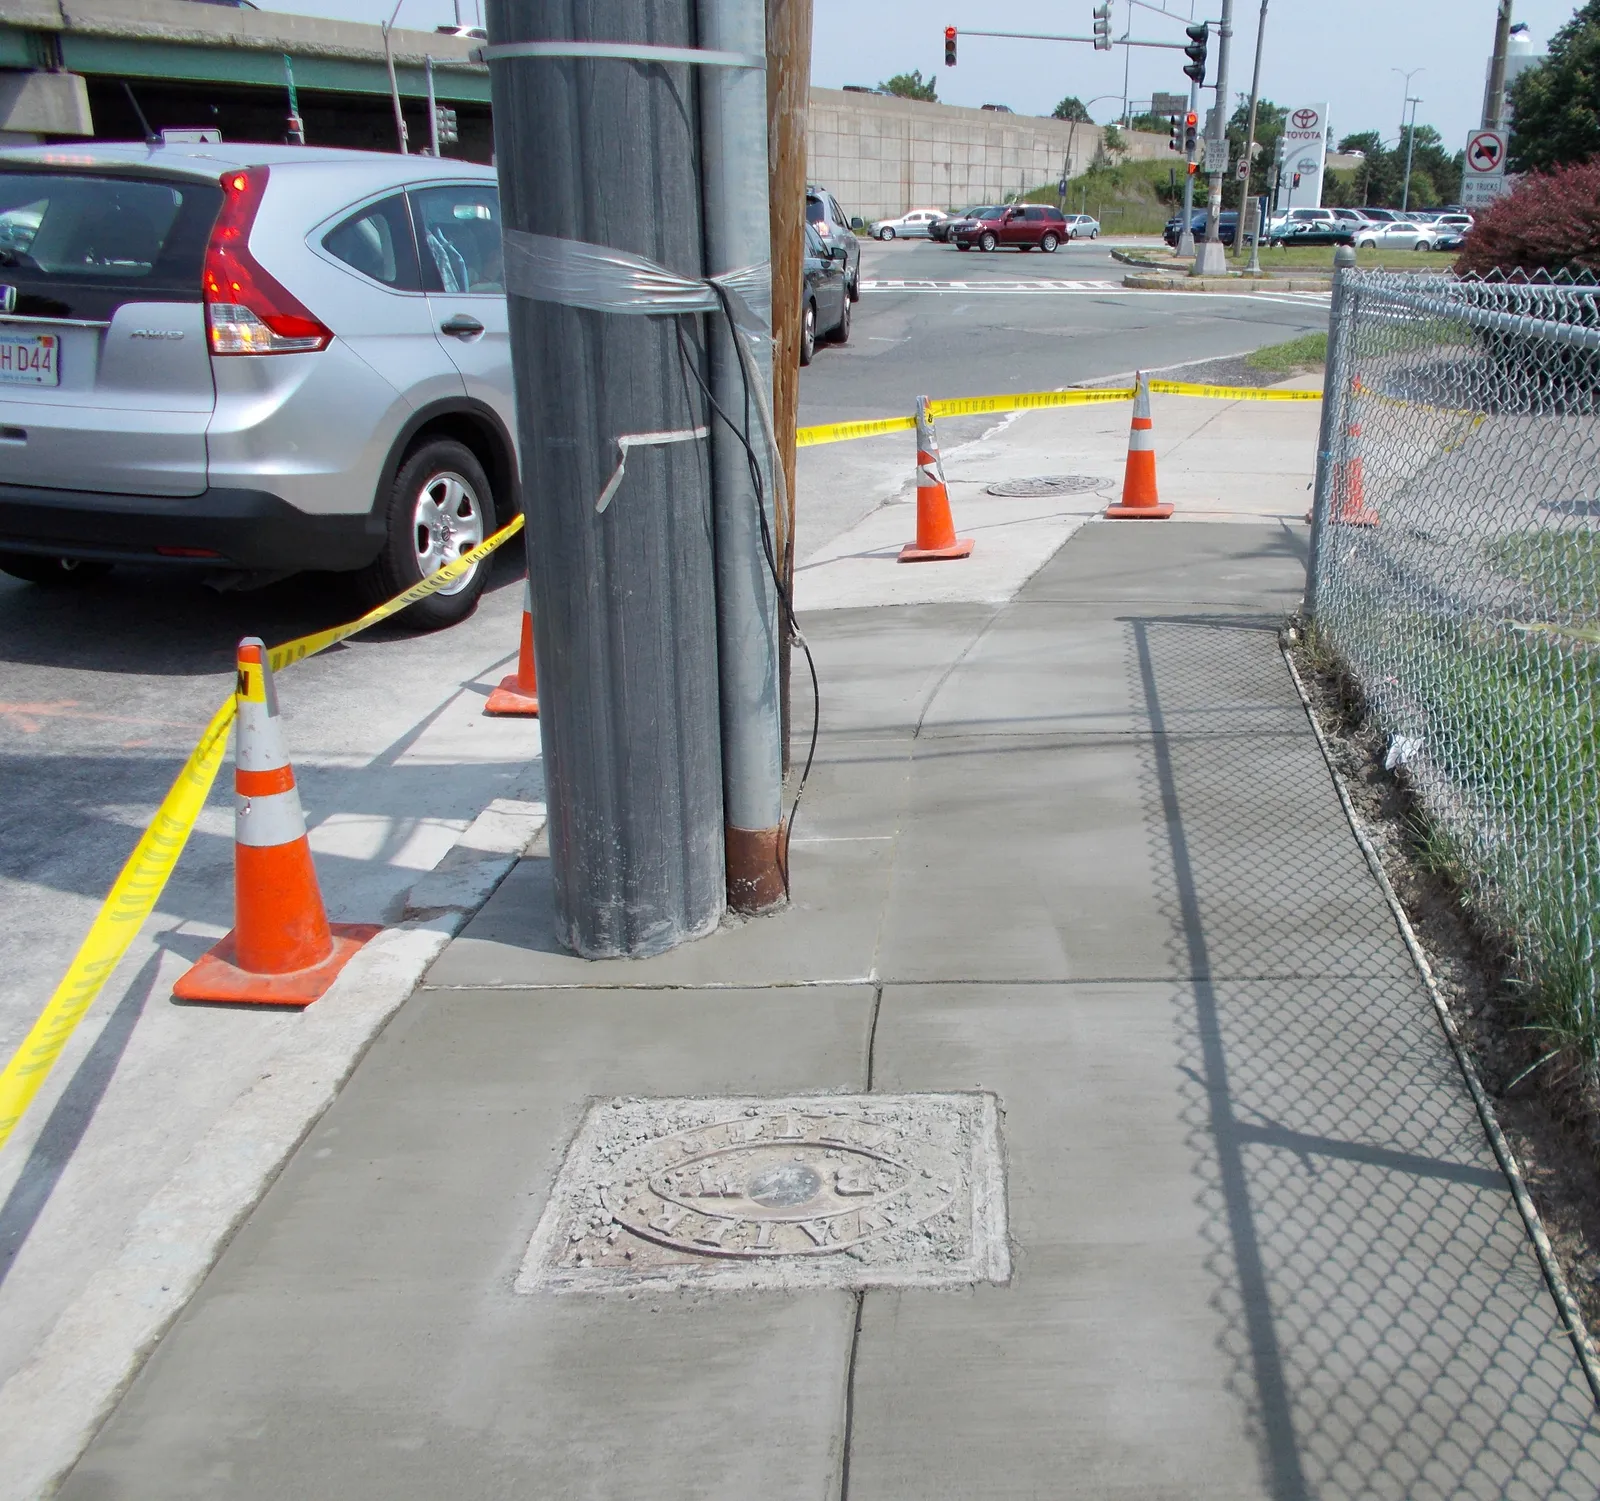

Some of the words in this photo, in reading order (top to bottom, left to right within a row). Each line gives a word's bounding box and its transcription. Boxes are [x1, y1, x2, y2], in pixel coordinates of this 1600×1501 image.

[1286, 131, 1321, 140] TOYOTA
[1465, 182, 1473, 190] NO
[1476, 182, 1498, 191] TRUCKS
[131, 328, 185, 341] AWD
[18, 345, 51, 373] D44
